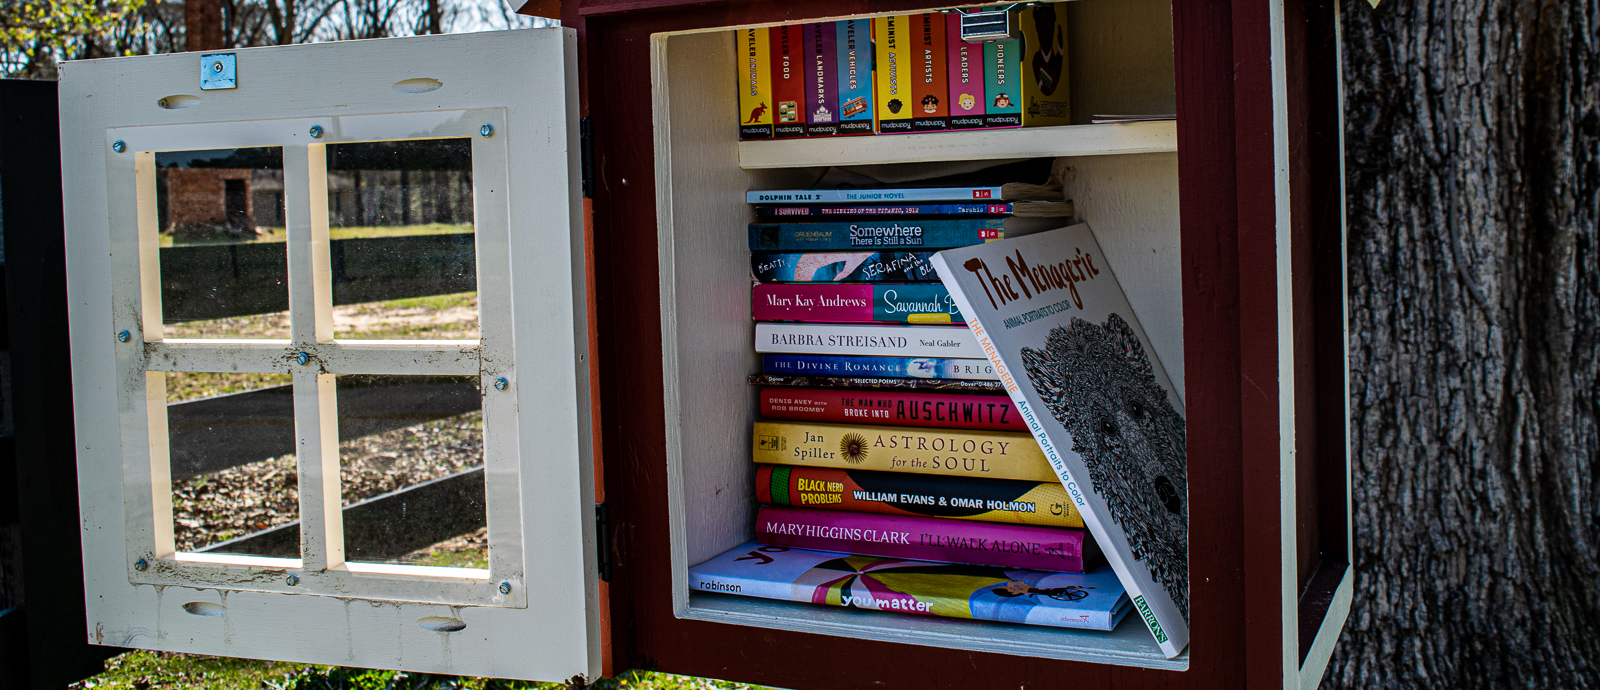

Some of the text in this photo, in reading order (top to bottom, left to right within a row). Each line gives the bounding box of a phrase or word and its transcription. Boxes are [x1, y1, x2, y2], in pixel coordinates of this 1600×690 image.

[848, 50, 857, 90] VEHICLES
[888, 52, 898, 95] ACTIVISTS
[924, 49, 932, 83] ARTISTS
[960, 46, 969, 84] LEADERS
[996, 44, 1005, 85] PIONEERS
[750, 58, 758, 96] ANIMALS
[816, 55, 824, 104] LANDMARKS
[778, 207, 810, 216] SURVIVED
[850, 224, 922, 237] Somewhere
[850, 237, 872, 245] There
[874, 237, 881, 245] Is
[884, 236, 898, 245] Still
[906, 236, 922, 245] Sun
[758, 258, 786, 274] BEATTY
[862, 252, 917, 280] SERAFINA
[904, 264, 914, 273] and
[963, 247, 1099, 310] The Menagerie
[766, 294, 866, 311] Mary Kay Andrews
[884, 290, 943, 314] Savannah
[1003, 315, 1025, 330] ANIMAL
[1046, 305, 1055, 315] TO
[1053, 300, 1072, 313] COLOR
[772, 334, 907, 348] BARBRA STREISAND
[936, 340, 961, 348] Gabler
[797, 361, 838, 370] DIVINE
[845, 362, 901, 371] ROMANCE
[841, 398, 892, 408] THE MAN WHO
[896, 400, 1009, 424] AUSCHWITZ
[844, 408, 889, 418] BROKE INTO
[969, 318, 1086, 507] THE MENAGERIE Animal Portraits to Color
[804, 432, 824, 444] Jan
[874, 435, 1010, 455] ASTROLOGY
[794, 447, 835, 460] Spiller
[890, 456, 990, 472] for the SOUL
[798, 478, 844, 492] BLACK NERD
[800, 493, 842, 505] PROBLEMS
[853, 490, 1036, 513] WILLIAM EVANS & OMAR HOLMON
[766, 522, 910, 545] MARY HIGGINS CLARK
[920, 533, 1040, 555] I'LL WALK ALONE
[700, 580, 742, 592] robinson
[841, 595, 934, 612] you matter
[1135, 596, 1167, 642] BARRON'S
